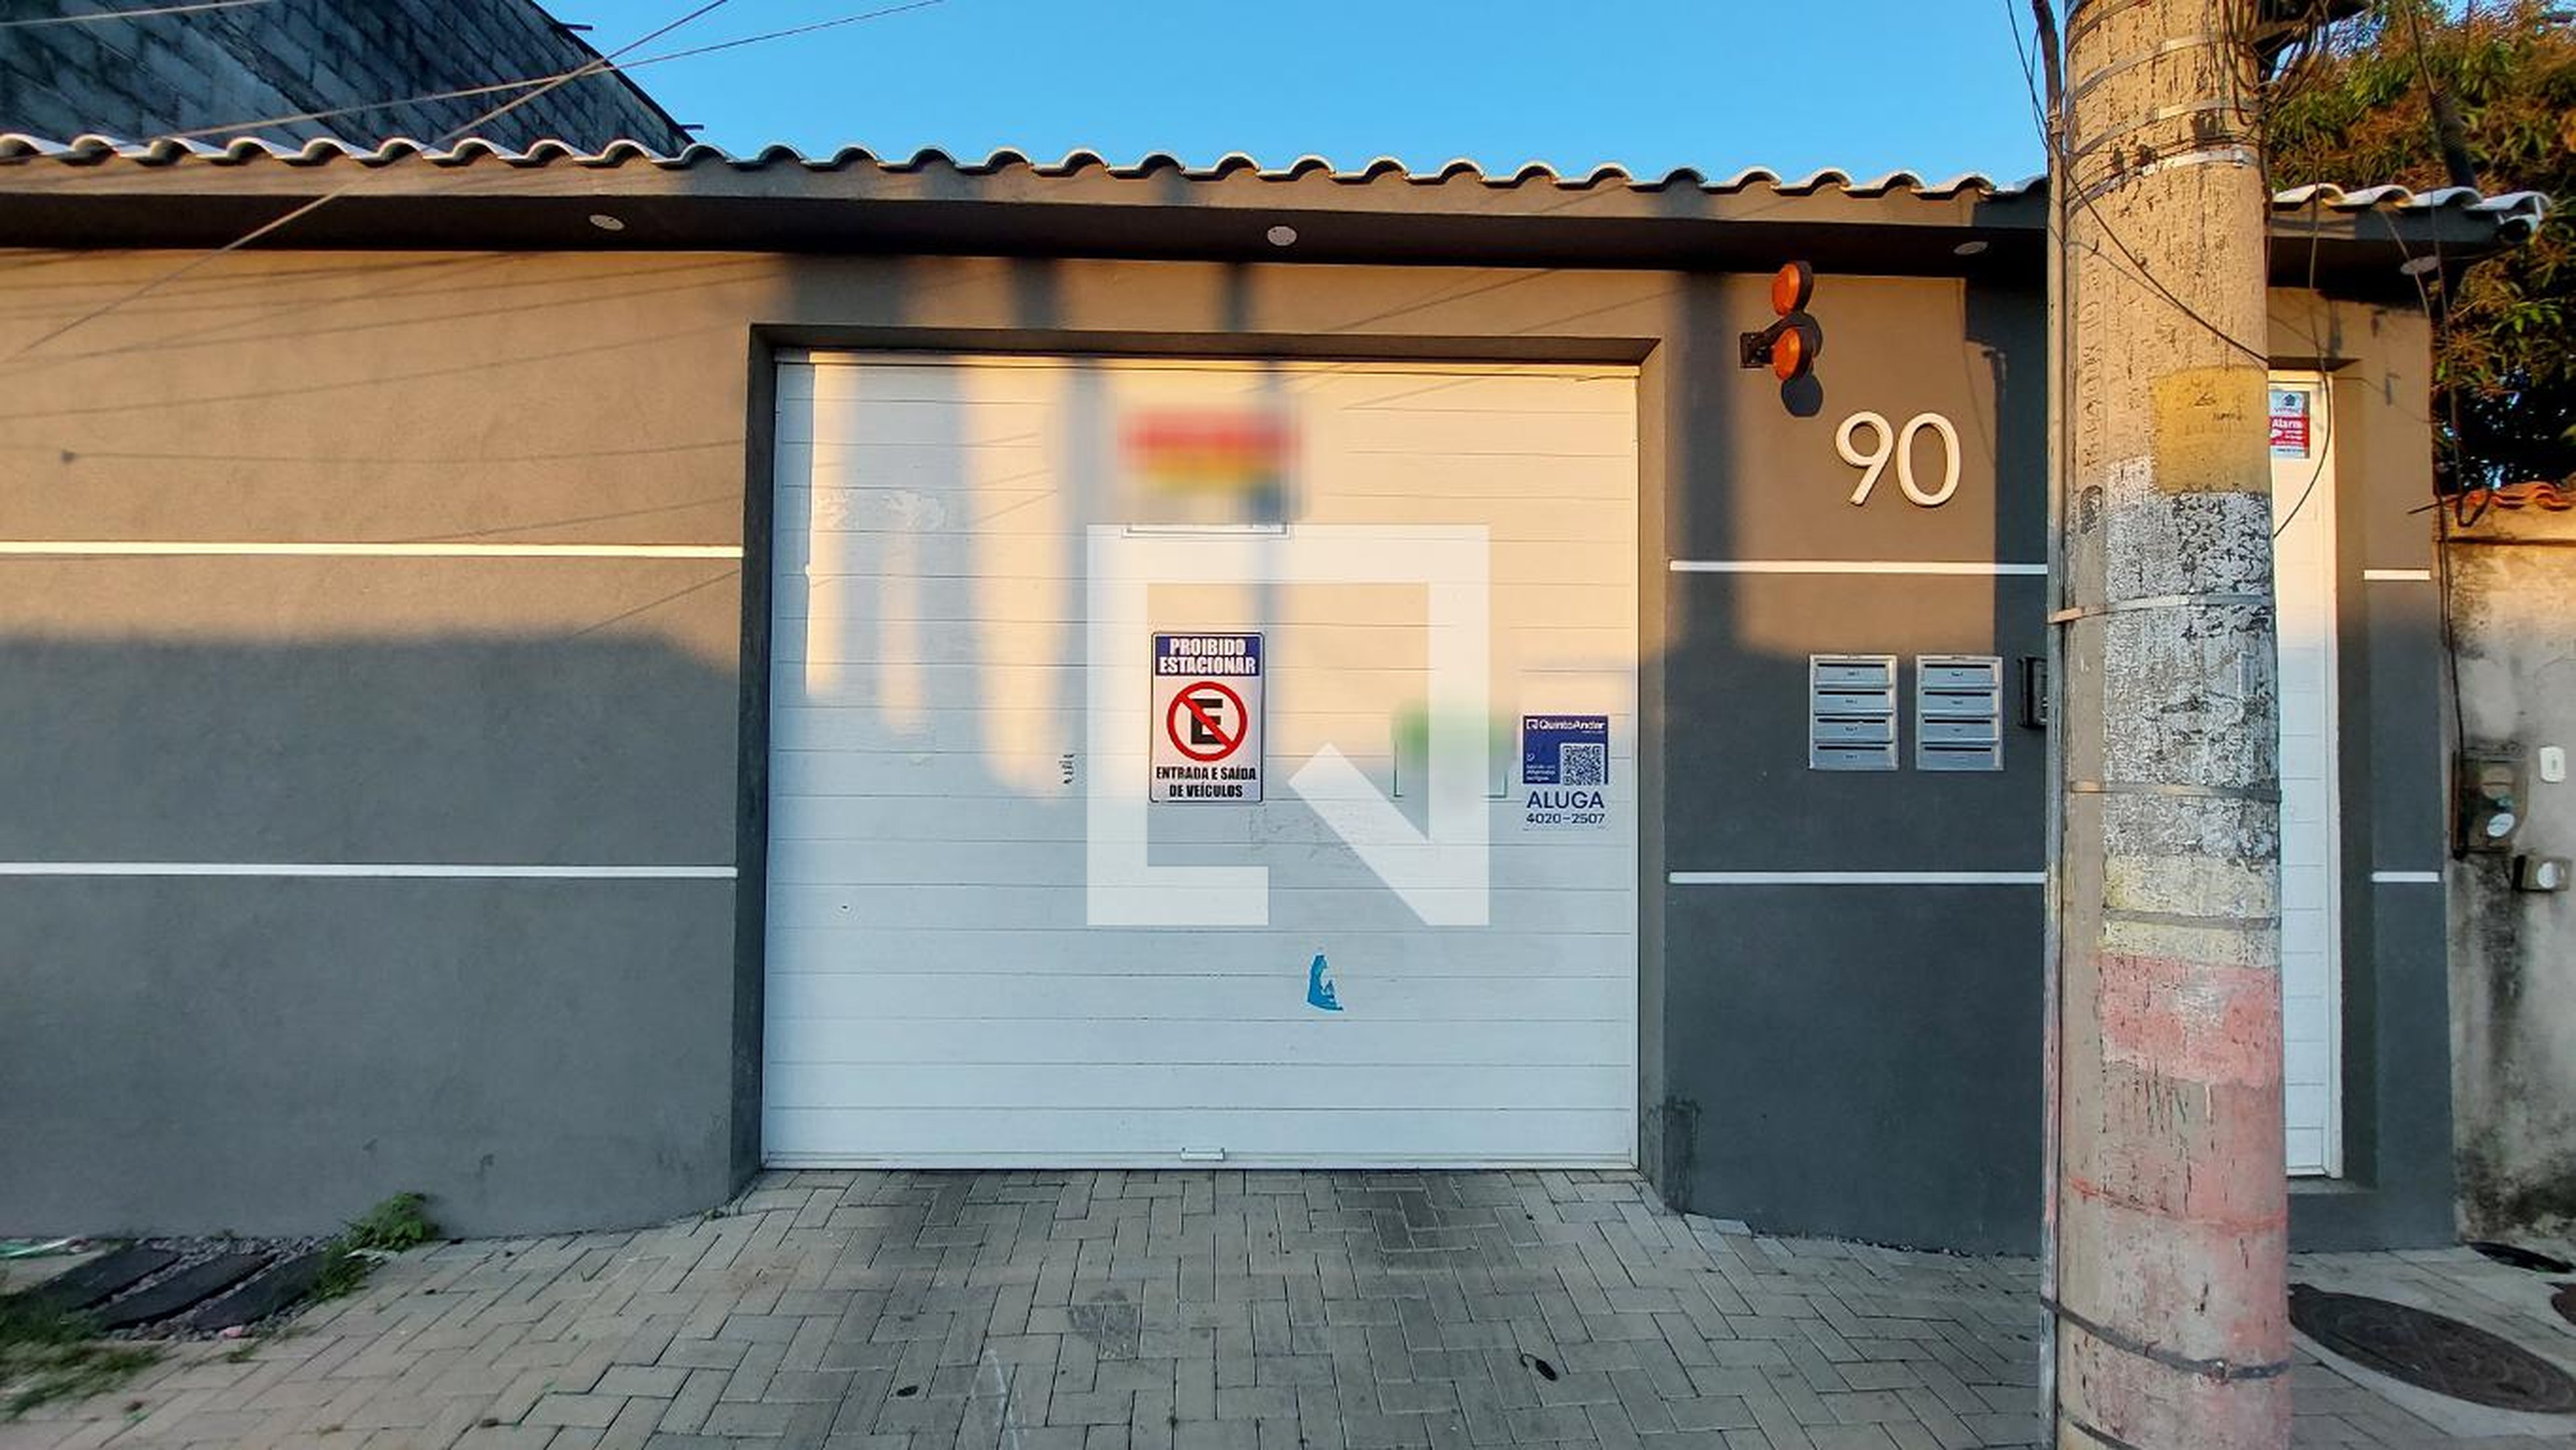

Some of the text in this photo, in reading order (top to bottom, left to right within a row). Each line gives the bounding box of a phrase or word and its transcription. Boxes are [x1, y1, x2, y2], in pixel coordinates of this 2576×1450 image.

[1835, 411, 1961, 506] 90
[1169, 639, 1246, 656] PROIBIDO
[1159, 656, 1256, 674] ESTACIONAR
[1156, 766, 1256, 780] ENTRADA E SAÍDA
[1169, 782, 1243, 798] DE VEÍCULOS
[1526, 790, 1605, 809] ALUGA
[1526, 813, 1605, 824] 4020-2507
